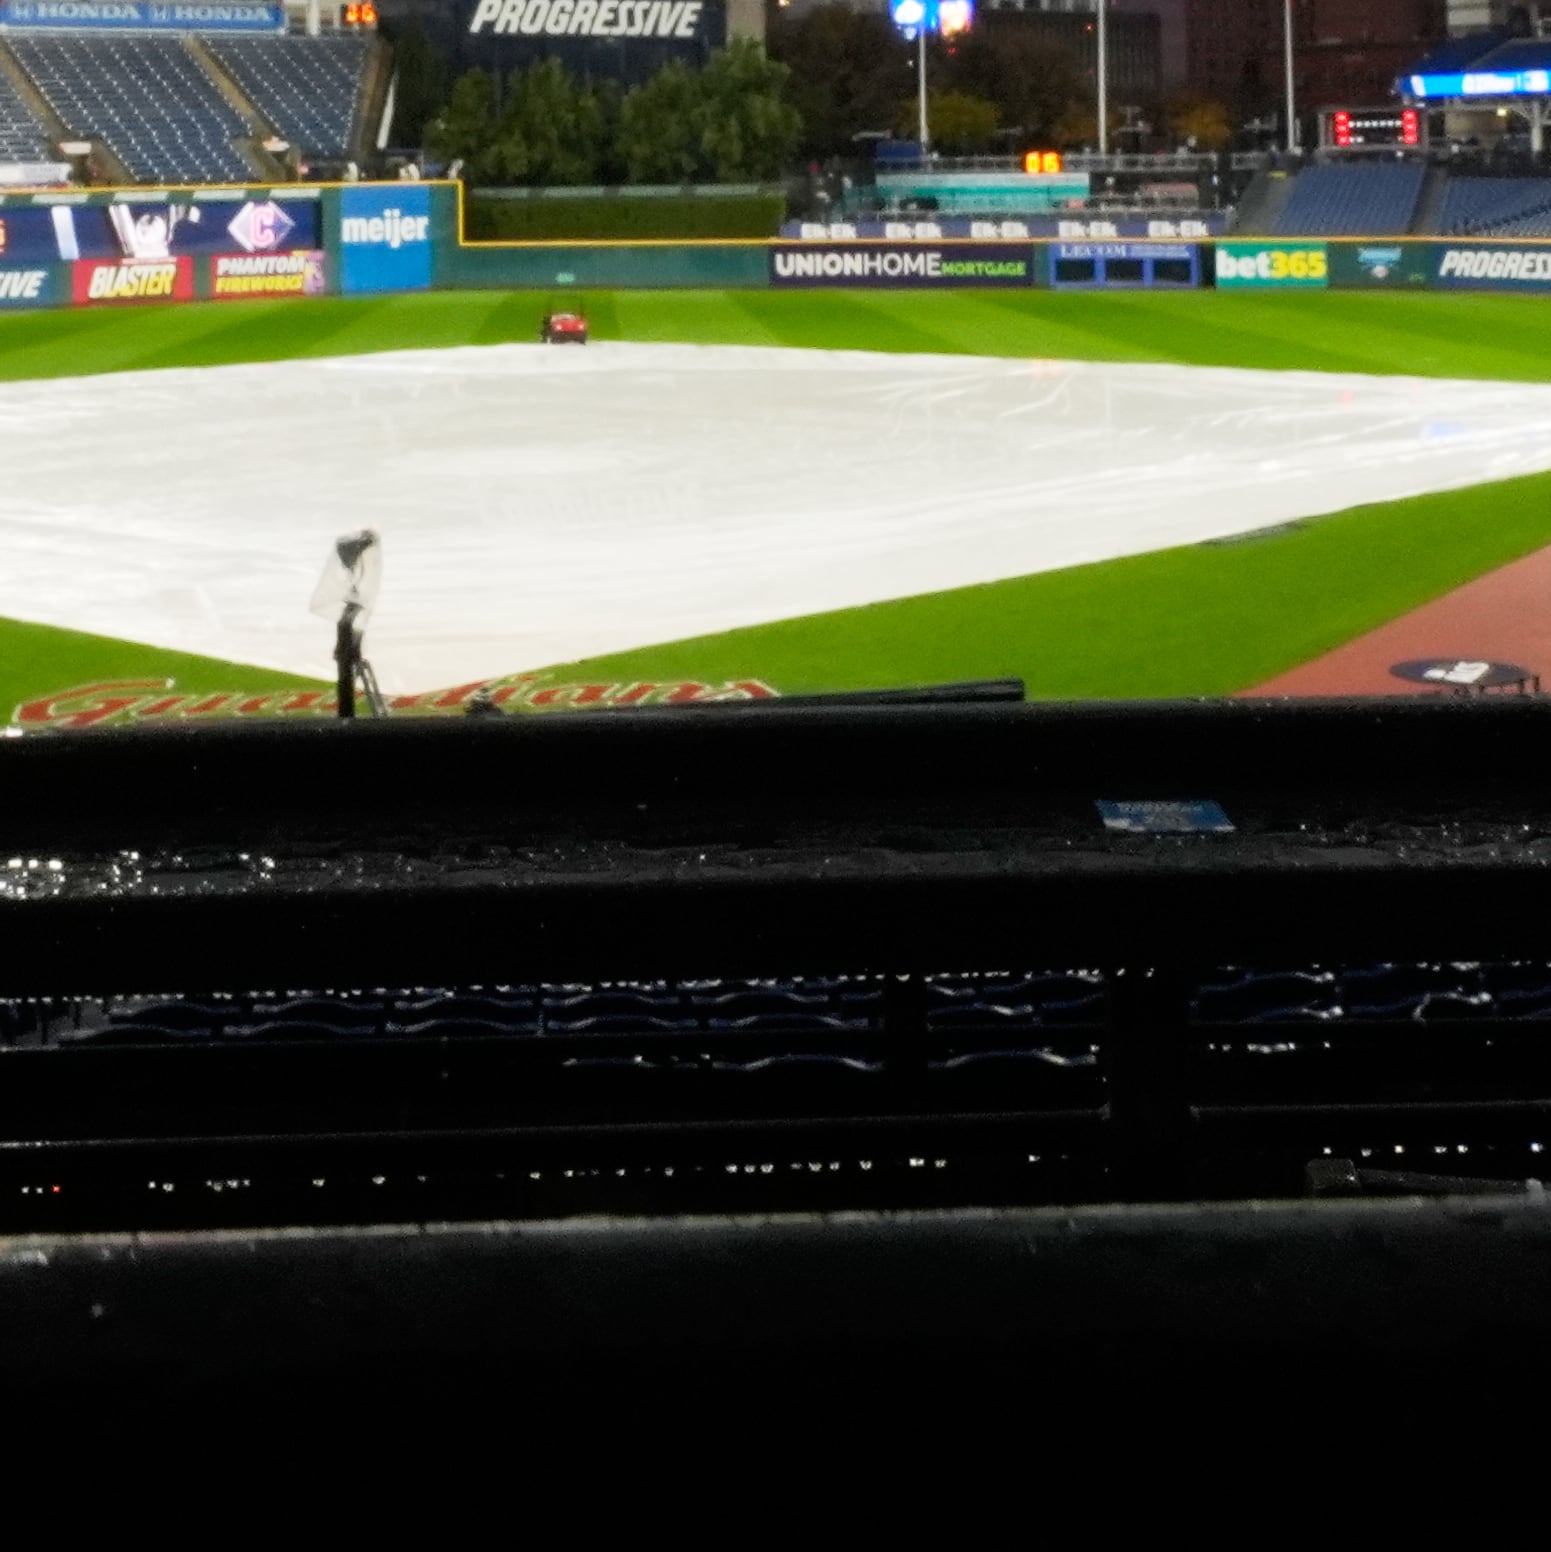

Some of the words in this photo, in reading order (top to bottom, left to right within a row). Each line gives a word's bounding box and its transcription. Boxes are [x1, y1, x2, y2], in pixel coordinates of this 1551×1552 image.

[37, 2, 141, 20] HONDA
[175, 5, 274, 22] HONDA
[250, 206, 276, 248] C
[341, 208, 429, 249] meijer
[216, 254, 305, 275] PHANTOM
[774, 252, 942, 277] UNIONHOME
[942, 260, 1027, 277] MORTGAGE
[1060, 243, 1127, 259] LECOM
[1215, 248, 1328, 278] bet365
[88, 263, 177, 299] BLASTER
[215, 273, 304, 293] FIREWORKS
[17, 674, 780, 728] Guadians
